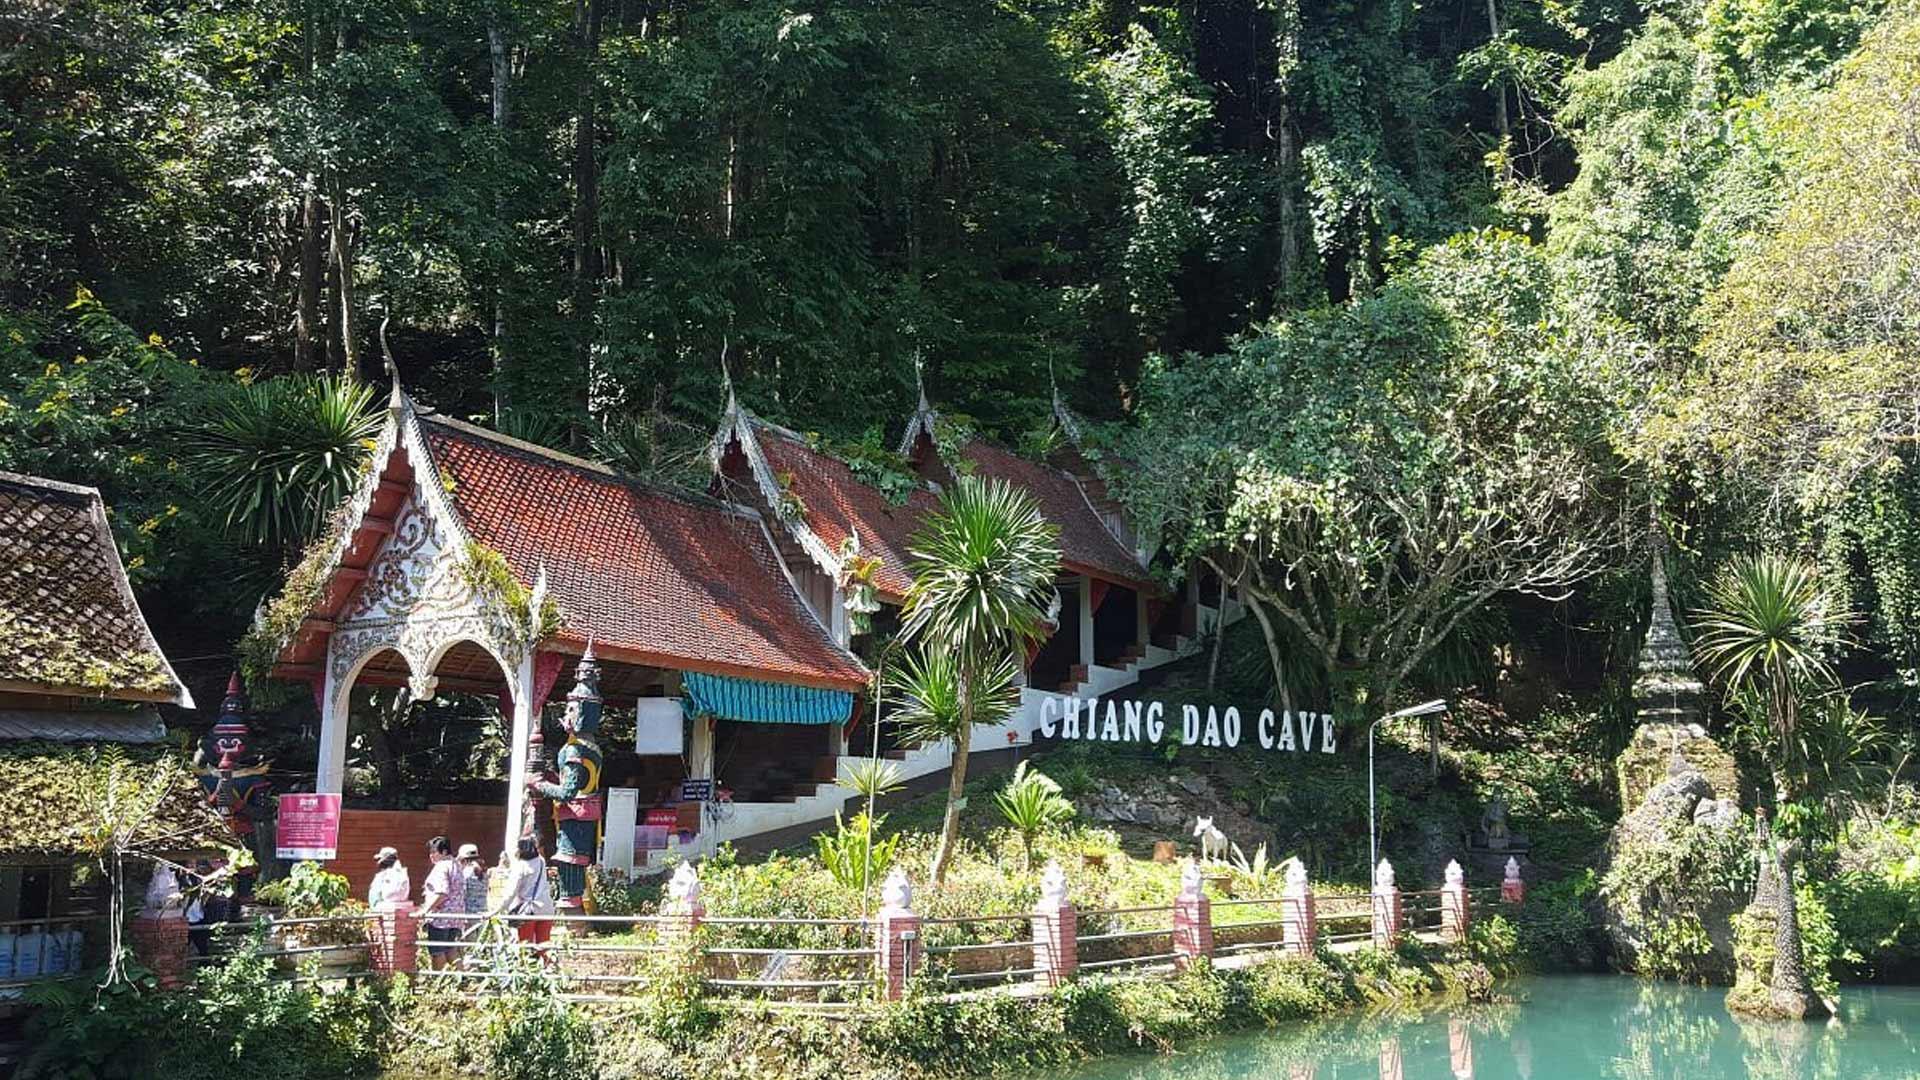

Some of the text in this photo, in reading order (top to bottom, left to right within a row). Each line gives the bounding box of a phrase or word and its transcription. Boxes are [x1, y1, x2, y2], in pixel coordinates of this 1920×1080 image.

[1040, 697, 1337, 754] CHIANG DAO CAVE
